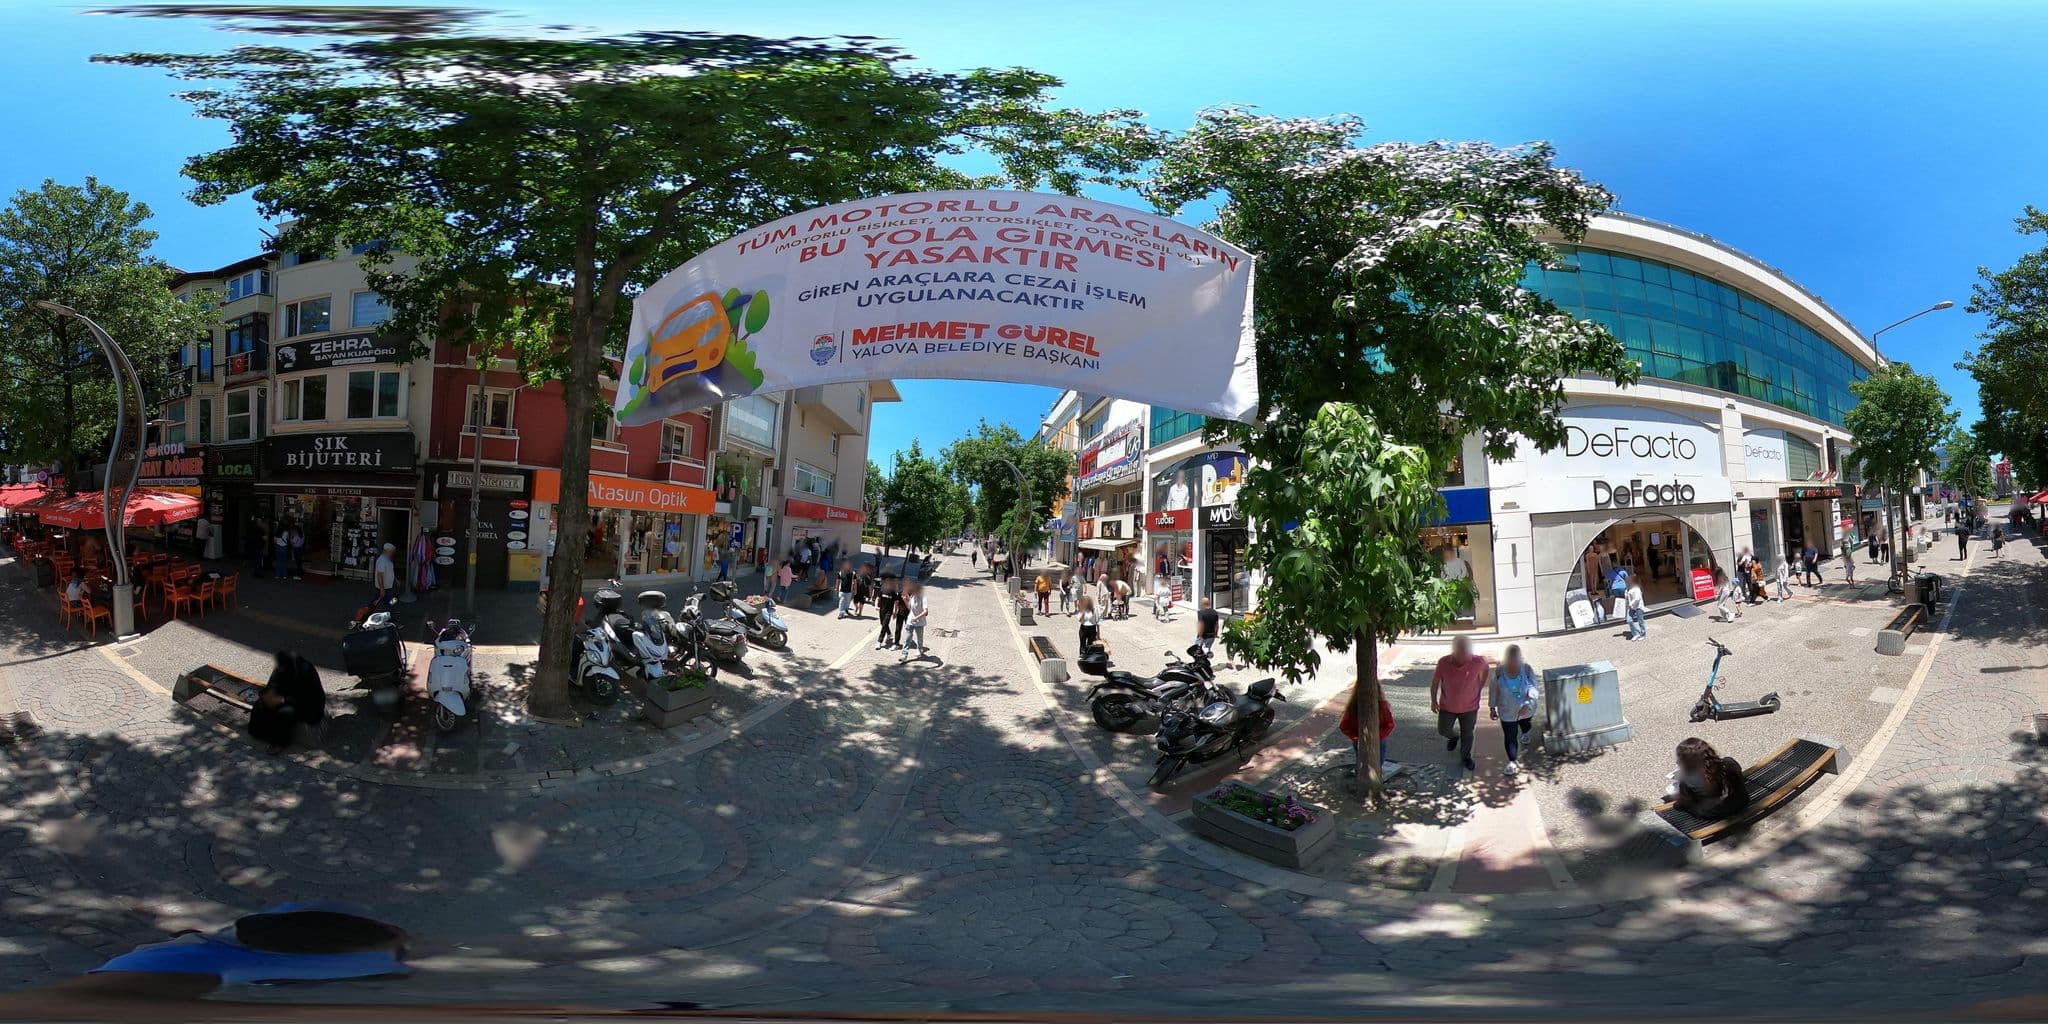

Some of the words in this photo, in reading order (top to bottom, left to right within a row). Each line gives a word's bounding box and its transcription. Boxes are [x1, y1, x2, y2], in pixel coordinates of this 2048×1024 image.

[738, 223, 797, 255] TÜM
[808, 199, 1019, 232] MOTORLU
[1035, 203, 1238, 273] ARAÇLARIN
[775, 227, 851, 255] (MOTORLU
[799, 237, 847, 263] BU
[862, 226, 978, 249] YOLA
[996, 225, 1167, 272] GİRMESİ
[864, 245, 1079, 273] YASAKTIR
[797, 279, 860, 302] GİREN
[866, 270, 996, 289] ARAÇLARA
[1004, 272, 1077, 294] CEZAİ
[1085, 280, 1147, 310] İŞLEM
[856, 287, 1085, 311] UYGULANACAKTIR
[310, 336, 373, 356] ZEHRA
[852, 320, 990, 346] MEHMET
[997, 323, 1100, 358] GÜREL
[314, 350, 346, 362] BAYAN
[347, 347, 396, 359] KUAFÖRÜ
[852, 342, 919, 360] YALOVA
[1023, 345, 1100, 370] BAŞKANI
[314, 435, 348, 452] ŞIK
[1565, 426, 1697, 461] DeFacto
[217, 464, 253, 476] LOCA
[286, 448, 382, 469] BİJUTERİ
[588, 480, 644, 503] Atasun
[648, 488, 688, 509] Optik
[1593, 479, 1696, 508] DeFacto
[1209, 507, 1232, 523] MAD
[733, 523, 742, 538] P
